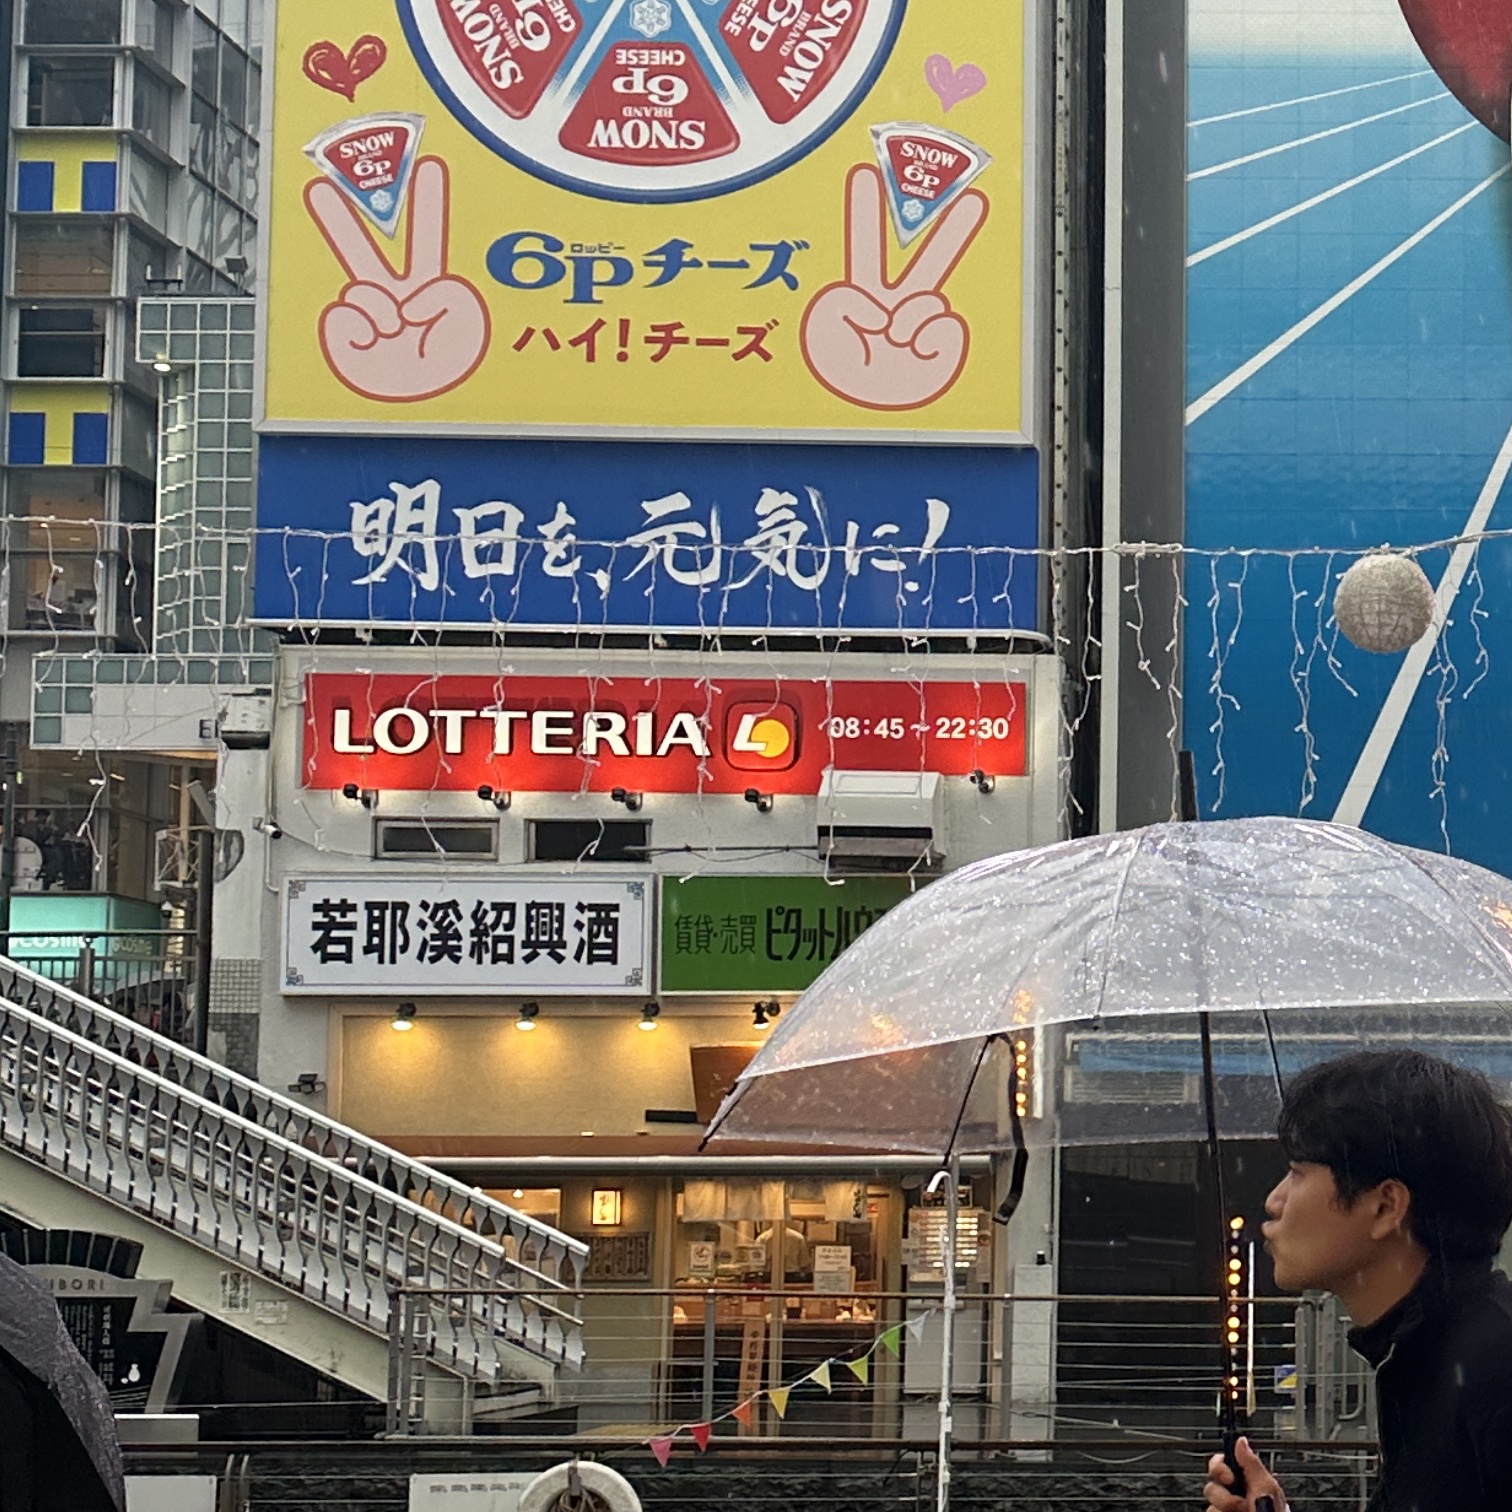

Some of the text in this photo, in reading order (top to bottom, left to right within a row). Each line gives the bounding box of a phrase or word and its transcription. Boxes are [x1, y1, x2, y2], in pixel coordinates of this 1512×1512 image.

[615, 48, 686, 66] CHEESE
[622, 106, 675, 118] BRAND
[339, 131, 395, 159] SNOW
[587, 119, 706, 150] SNOW
[900, 141, 959, 169] SNOW
[511, 317, 781, 363] ハイ!チーズ
[332, 707, 712, 757] LOTTERIA
[830, 716, 905, 740] 08:45
[935, 716, 1010, 740] 22:30
[310, 897, 620, 966] 若耶溪紹興酒
